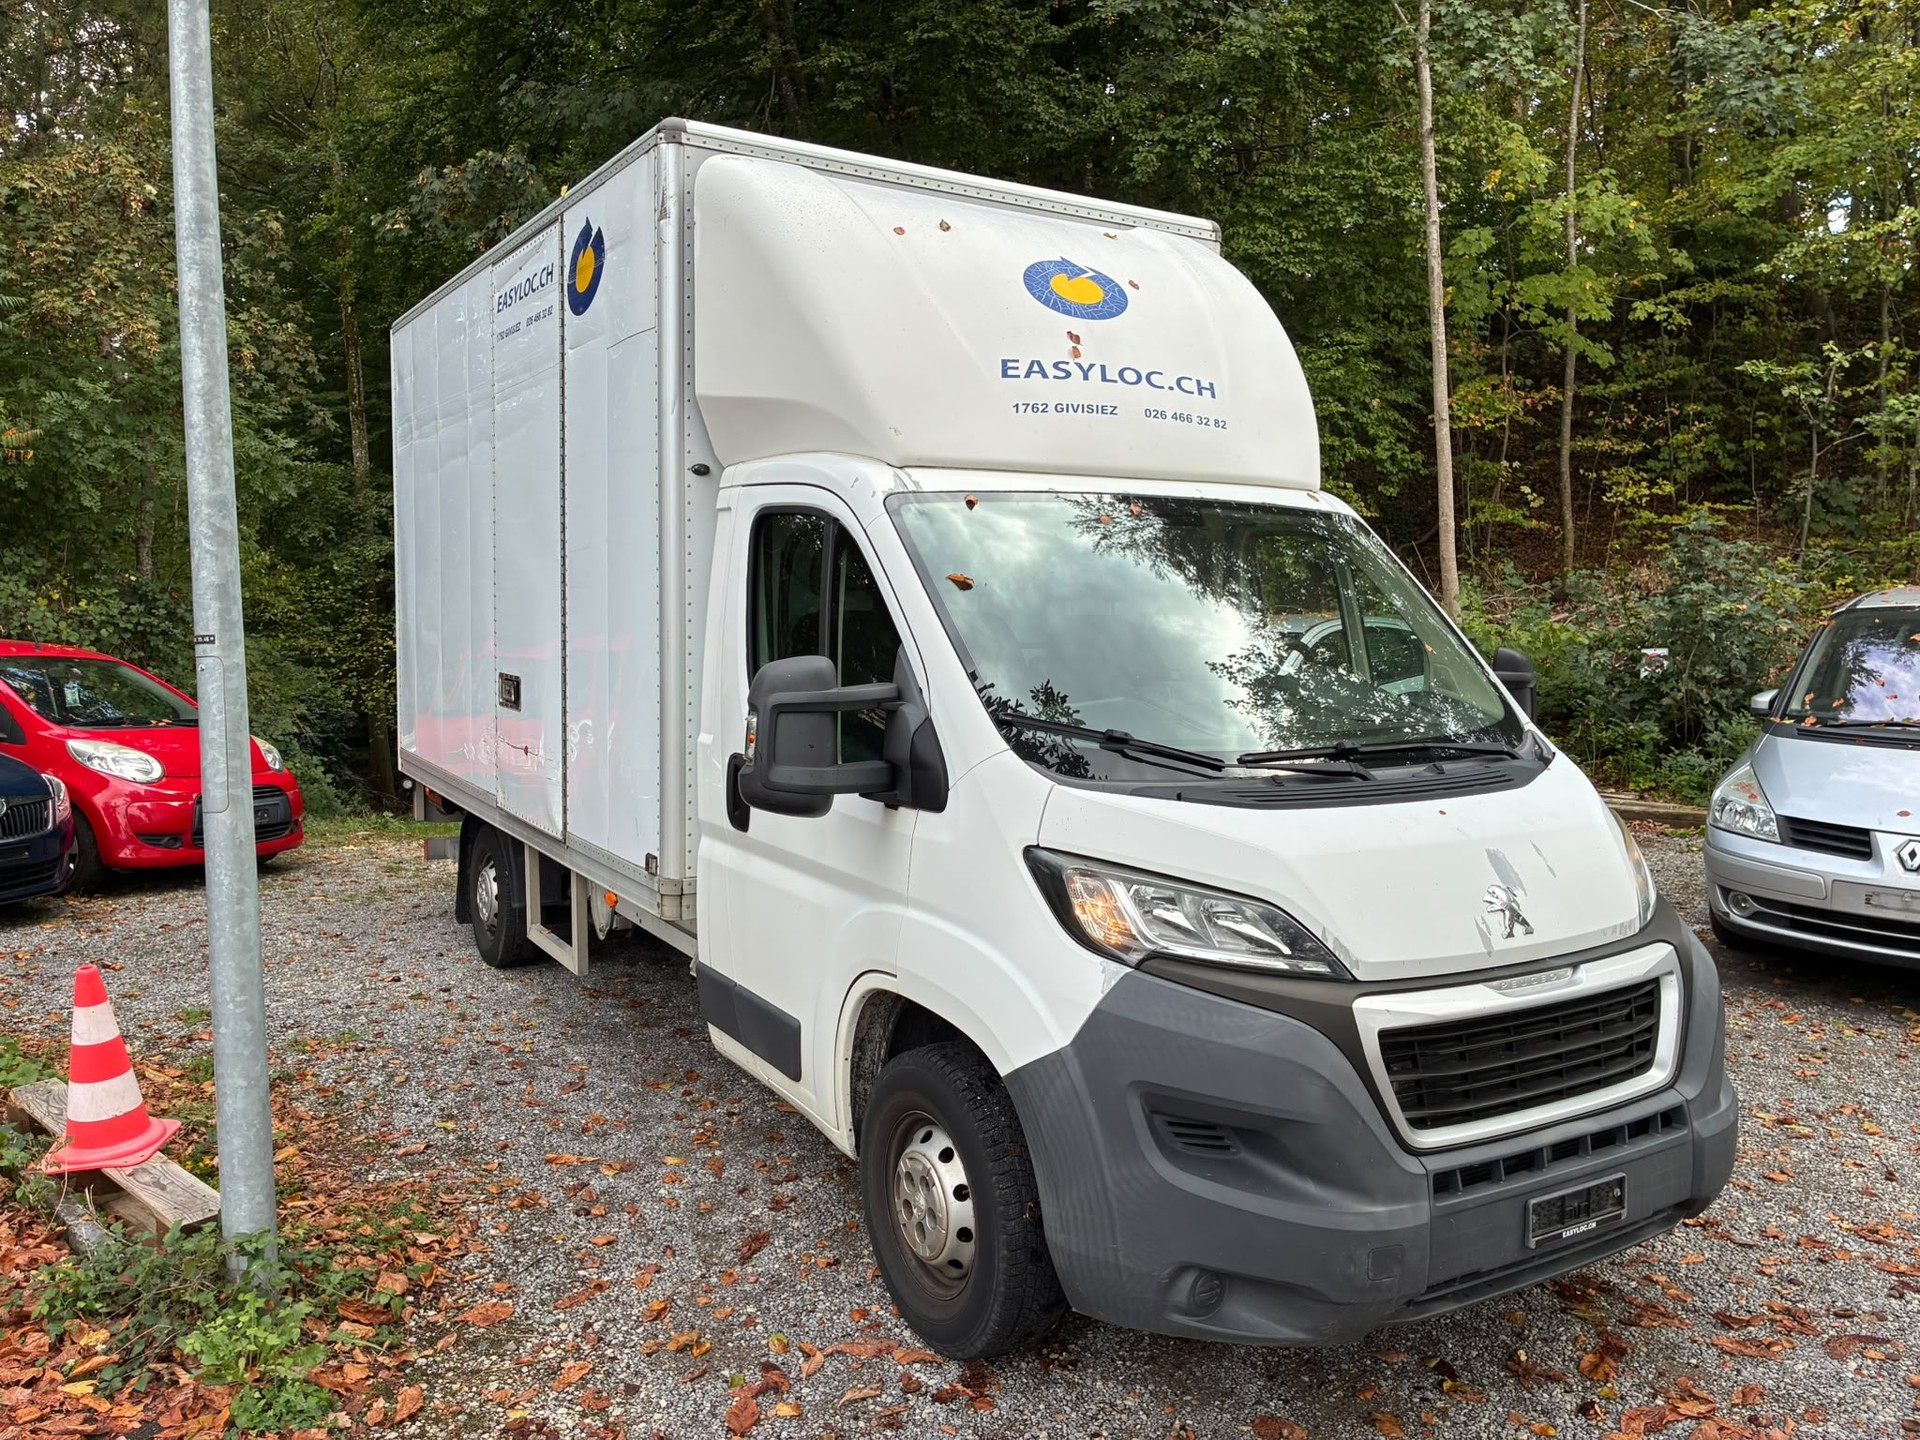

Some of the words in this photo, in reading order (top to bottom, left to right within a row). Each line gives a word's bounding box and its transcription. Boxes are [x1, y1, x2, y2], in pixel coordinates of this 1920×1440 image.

[497, 262, 554, 314] EASYLOC.CH
[1000, 358, 1217, 399] EASYLOC.CH
[1012, 402, 1049, 414] 1762
[1054, 403, 1119, 416] GIVISIEZ
[1144, 408, 1168, 420] 026
[1171, 411, 1193, 424] 466
[1196, 415, 1211, 427] 32
[1213, 418, 1228, 430] 82
[1563, 1222, 1596, 1238] EASYLOC.CH
